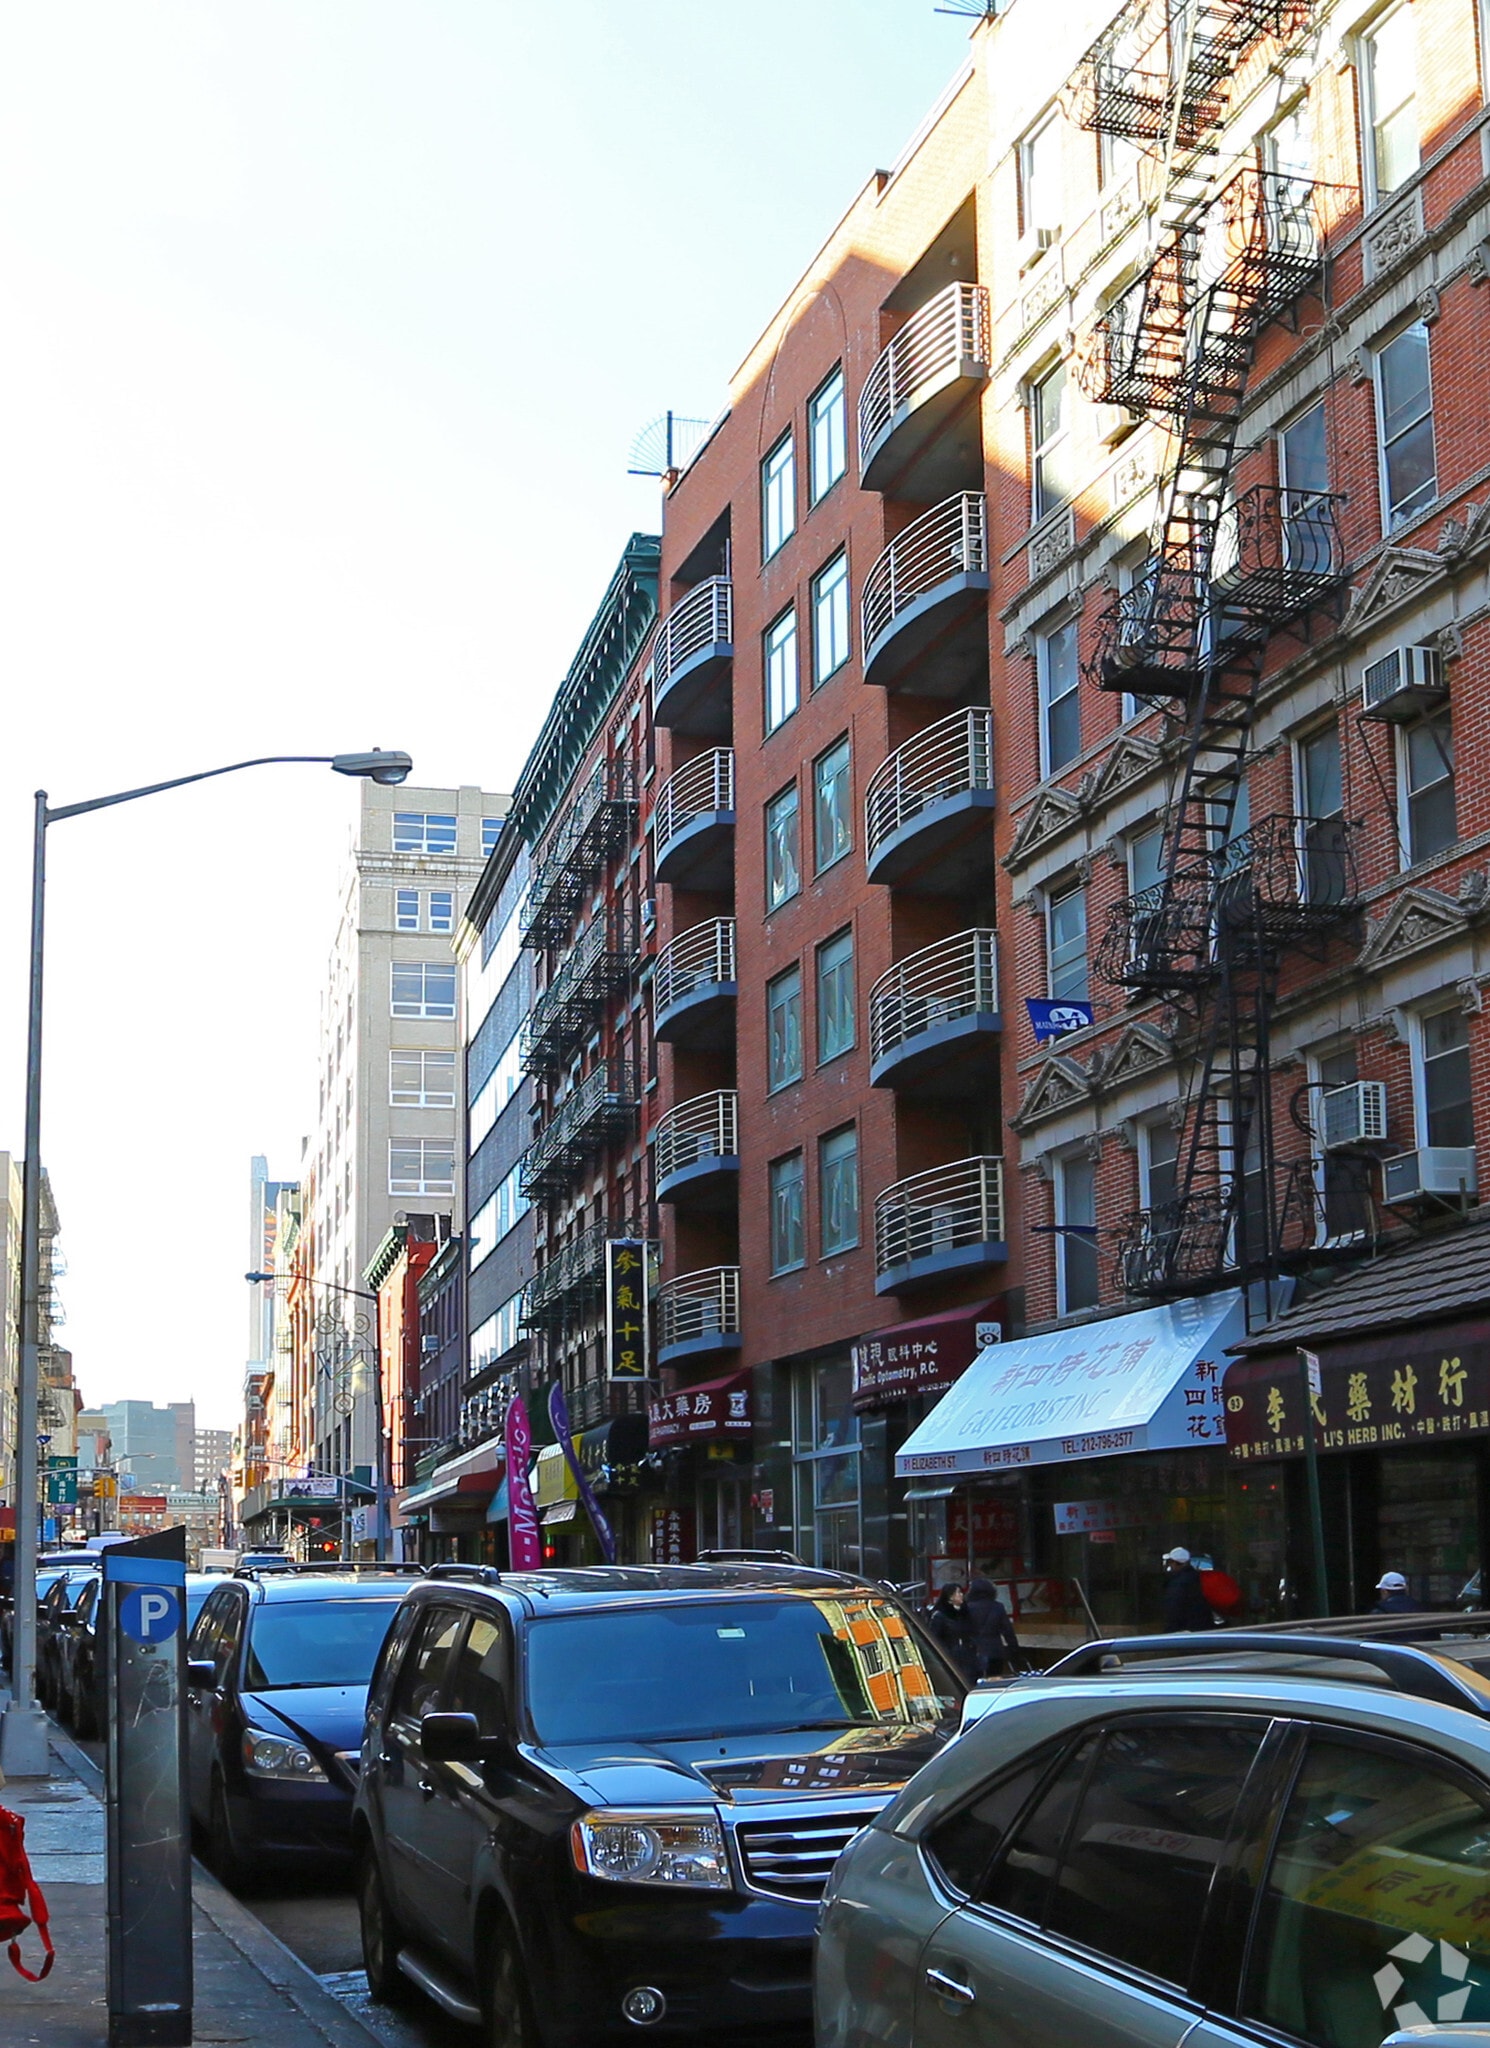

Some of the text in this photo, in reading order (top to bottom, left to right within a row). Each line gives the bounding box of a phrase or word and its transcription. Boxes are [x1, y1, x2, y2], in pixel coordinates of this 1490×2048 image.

[877, 1365, 917, 1385] Optometry,
[919, 1361, 938, 1375] P.C.
[1195, 1360, 1218, 1382] 新
[992, 1395, 1076, 1432] FLORIST
[1061, 1431, 1134, 1455] TEL: 212-796-2577
[1323, 1429, 1344, 1447] LI'S
[1348, 1426, 1378, 1445] HERB
[1381, 1422, 1406, 1441] INC.
[911, 1456, 946, 1470] ELIZABETH
[140, 1594, 169, 1637] P
